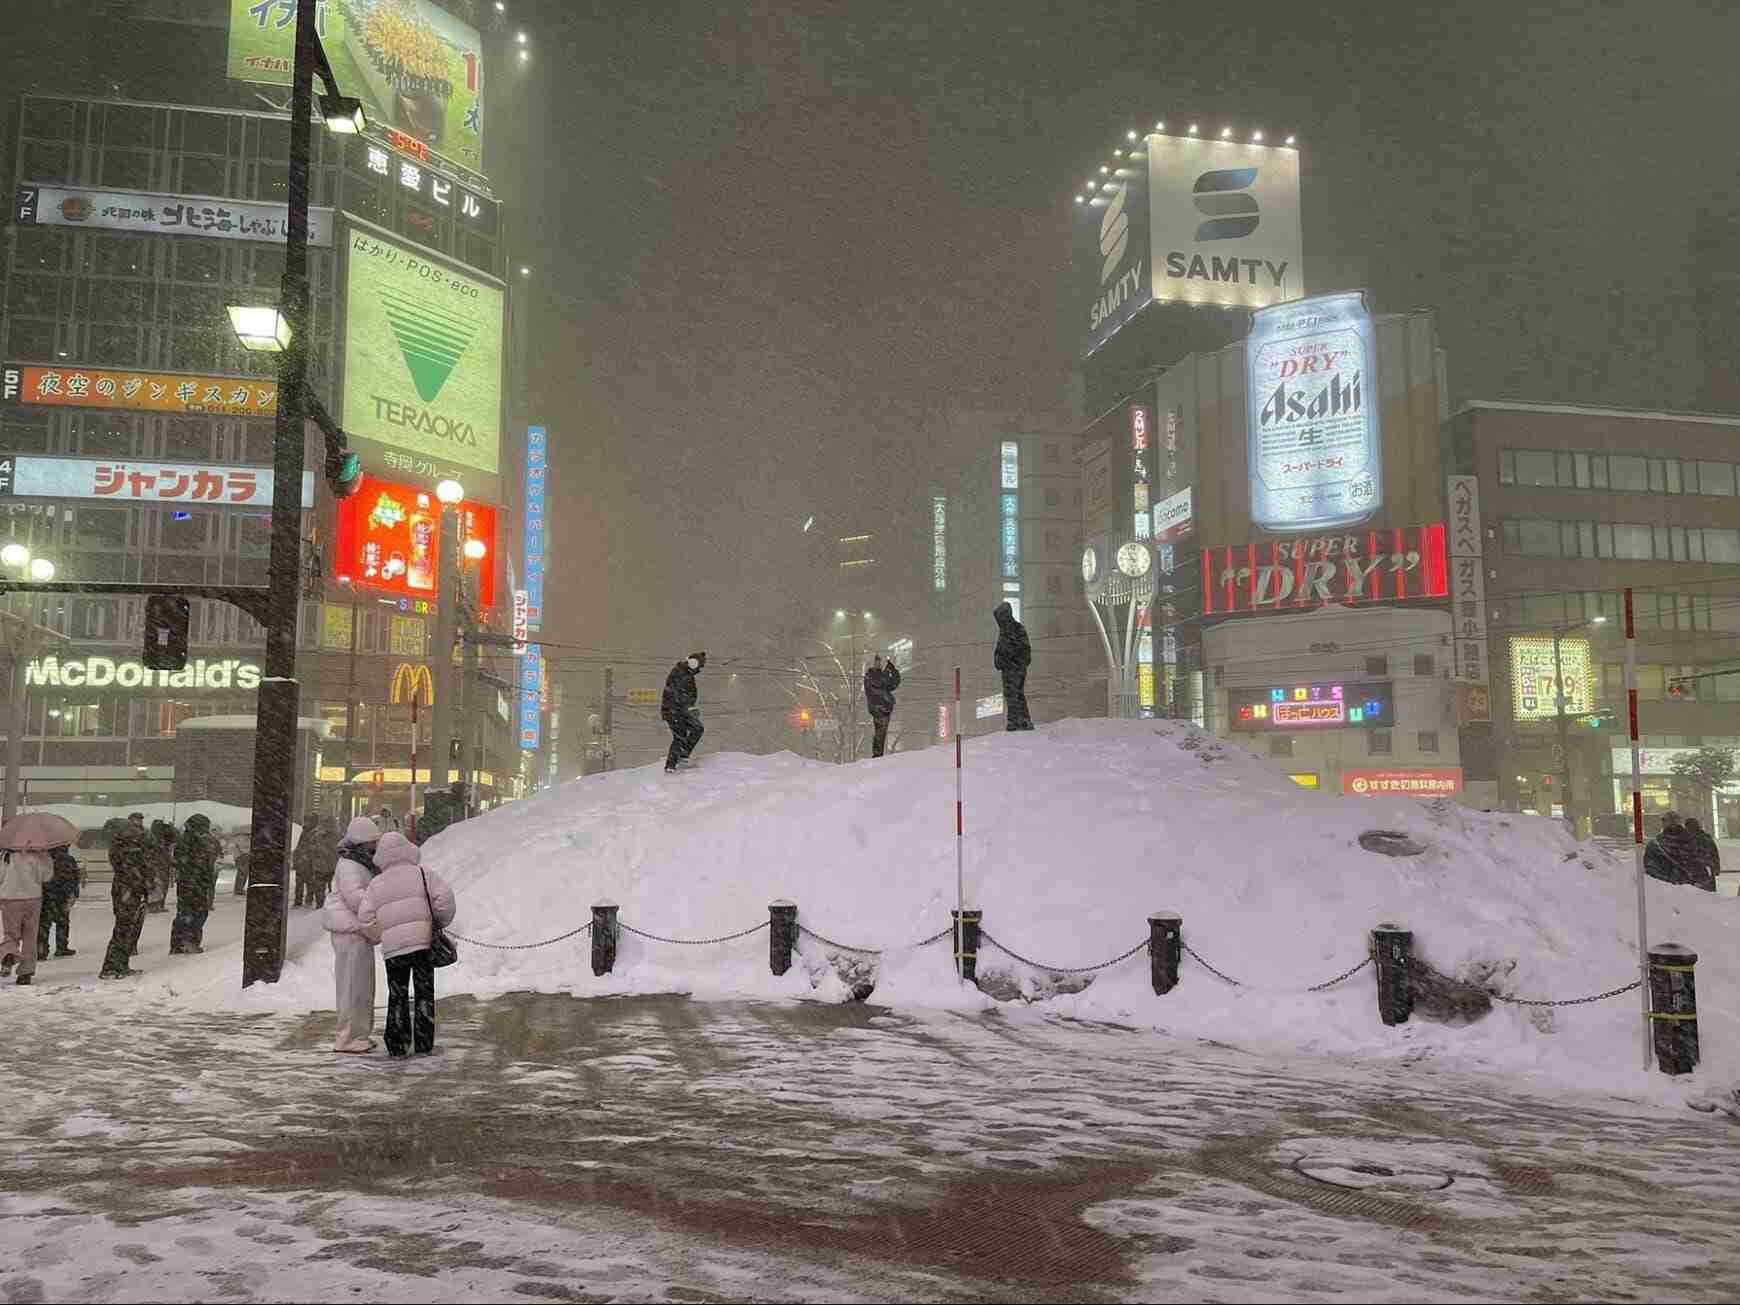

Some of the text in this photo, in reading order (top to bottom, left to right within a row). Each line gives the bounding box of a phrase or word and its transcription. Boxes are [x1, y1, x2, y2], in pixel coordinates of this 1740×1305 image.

[1166, 252, 1289, 287] SAMTY
[1090, 259, 1143, 330] SAMTY
[38, 373, 276, 408] 夜空のジンギスカン
[1261, 368, 1361, 426] Asahi
[370, 395, 477, 447] TERAOKA
[1298, 427, 1323, 446] 生
[1281, 456, 1344, 473] スーパードライ
[94, 464, 257, 502] ジャンカラ
[1278, 536, 1360, 560] SUPER
[25, 657, 261, 688] McDonald's
